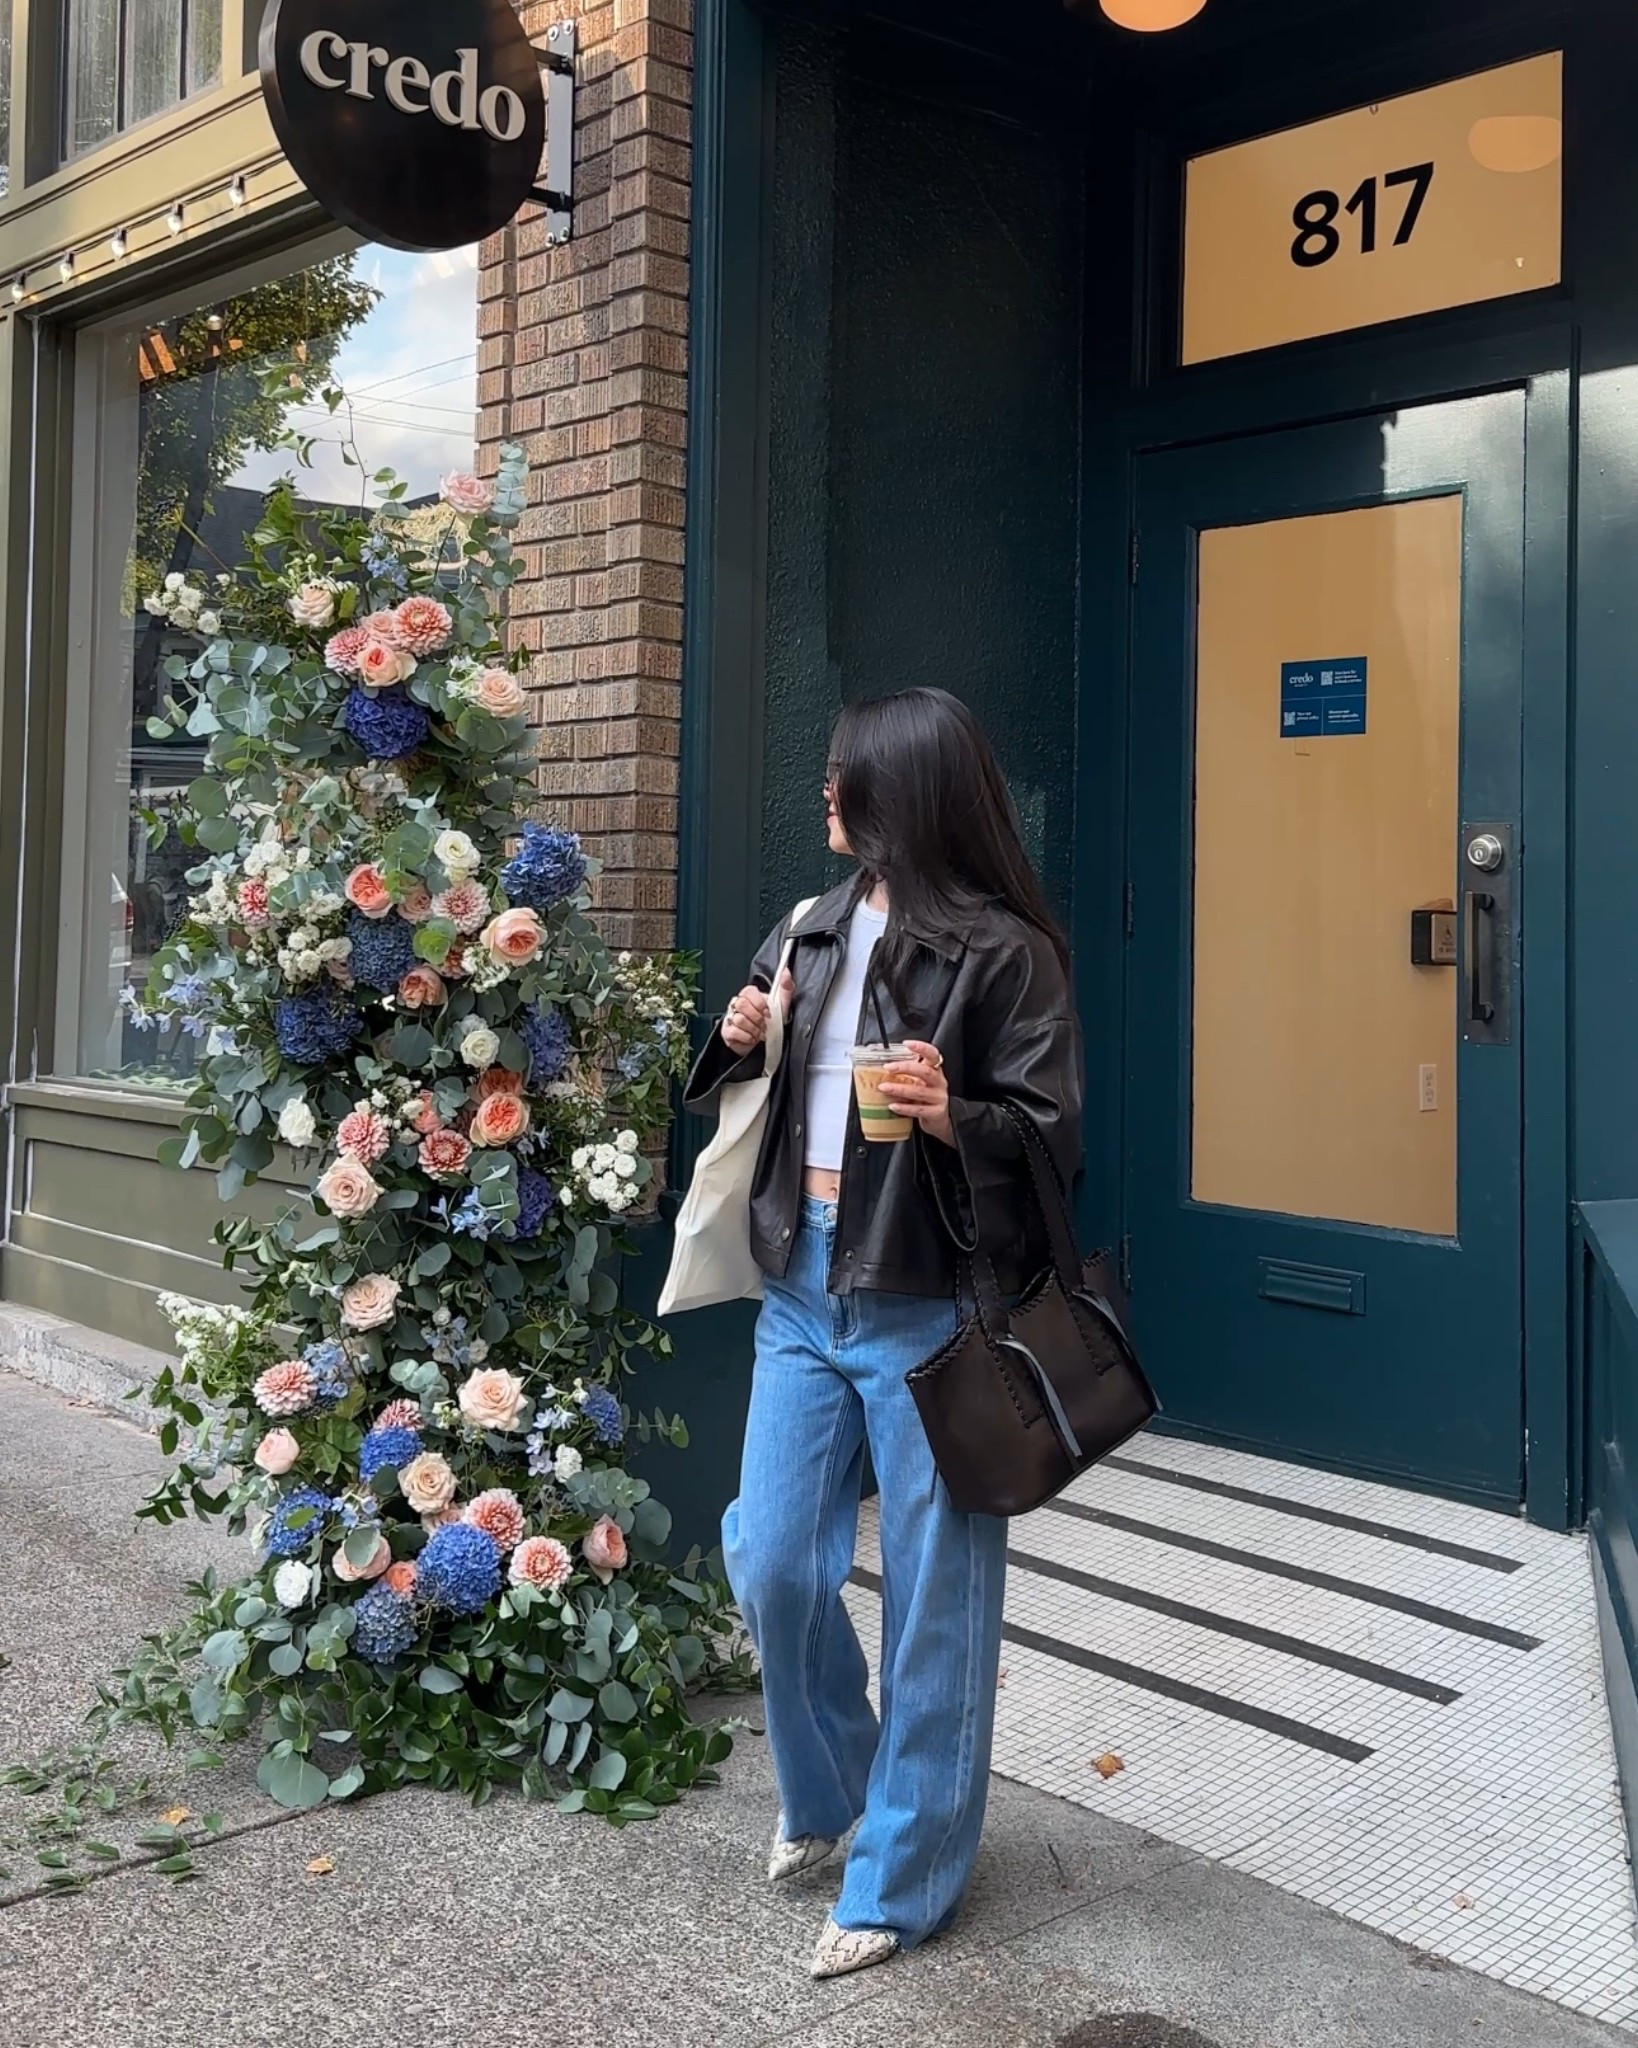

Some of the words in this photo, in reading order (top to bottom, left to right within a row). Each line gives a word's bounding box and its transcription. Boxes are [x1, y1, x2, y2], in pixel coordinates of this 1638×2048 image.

[300, 30, 526, 142] credo
[1290, 161, 1434, 268] 817
[1289, 672, 1313, 684] credo
